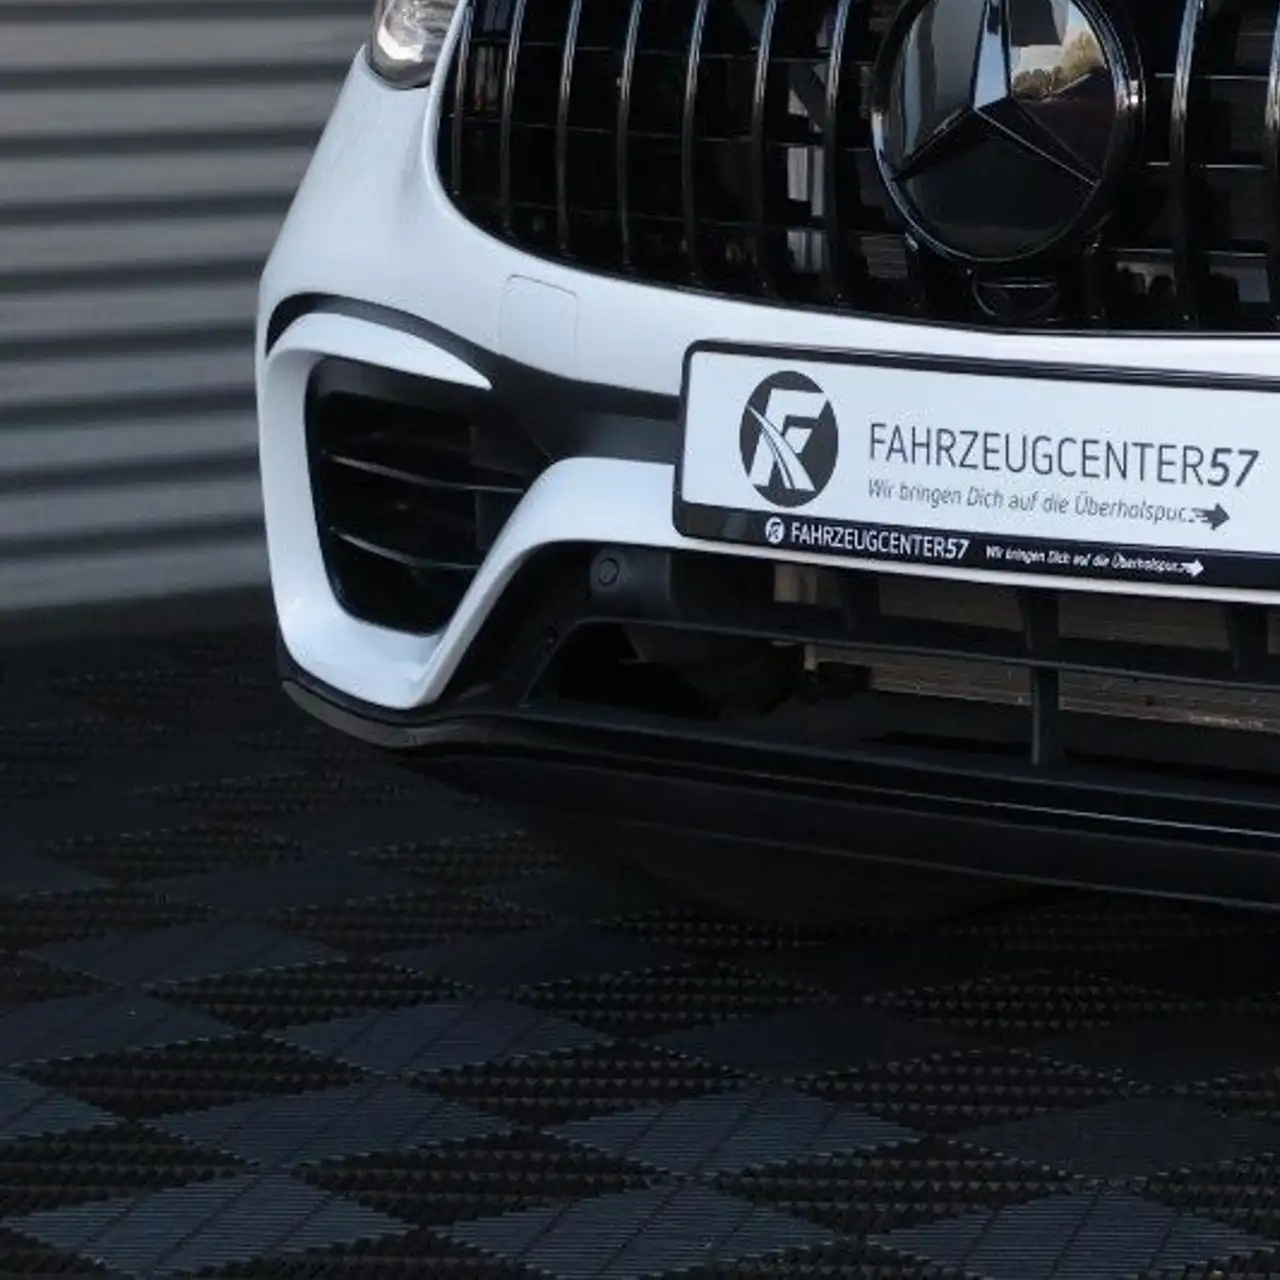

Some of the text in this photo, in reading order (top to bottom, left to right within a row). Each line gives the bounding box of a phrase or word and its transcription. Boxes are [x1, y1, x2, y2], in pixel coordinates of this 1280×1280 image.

[869, 421, 1260, 489] FAHRZEUGCENTER57
[868, 477, 896, 500] Wir
[899, 481, 962, 509] bringen
[966, 485, 1004, 509] Dich
[1008, 490, 1038, 512] auf
[1042, 493, 1070, 515] die
[791, 521, 971, 560] FAHRZEUGCENTER57
